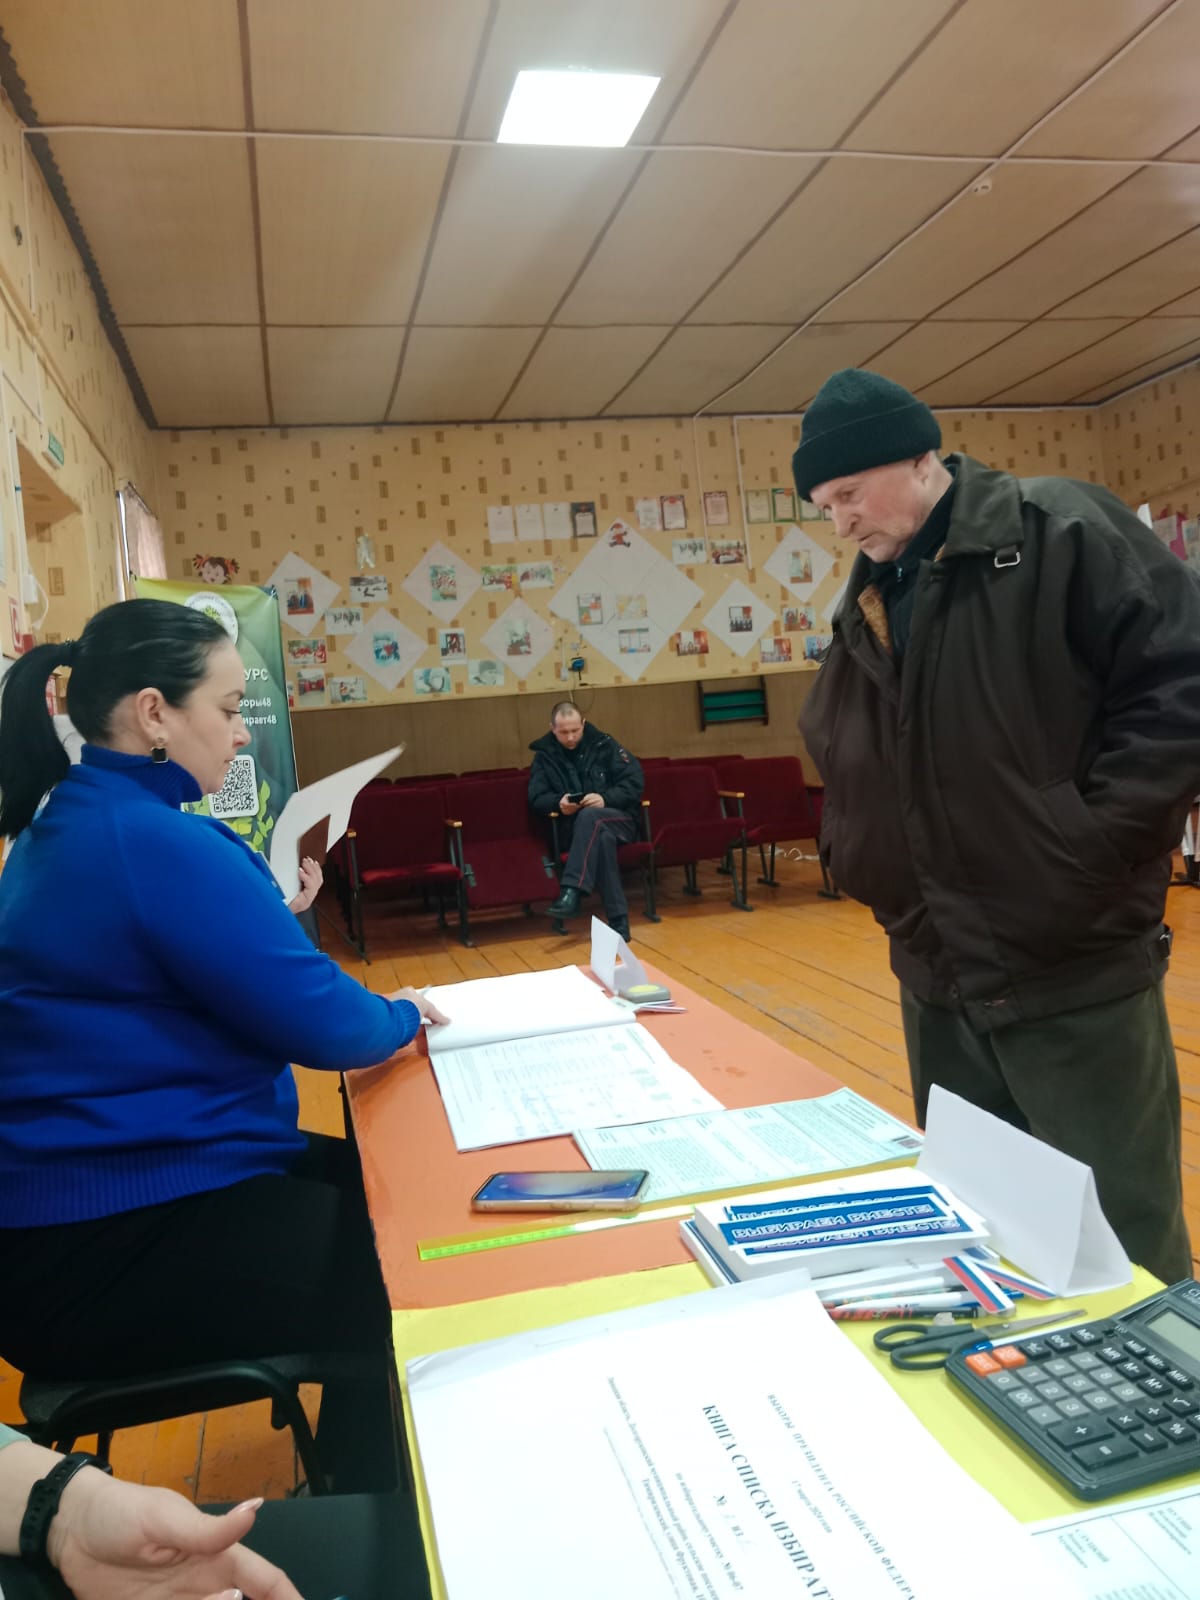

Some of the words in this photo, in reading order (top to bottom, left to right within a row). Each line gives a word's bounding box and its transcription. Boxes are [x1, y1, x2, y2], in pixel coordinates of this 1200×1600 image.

[731, 1214, 847, 1240] ВЫБИРАЕМ
[702, 1404, 738, 1452] КНИГА
[731, 1454, 777, 1520] СПИСКА
[770, 1519, 834, 1600] ИЗБИРАТ
[766, 1394, 796, 1430] ВЫБОРЫ
[792, 1432, 835, 1493] ПРЕЗИДЕНТА
[832, 1492, 886, 1555] РОССИЙСКОЙ
